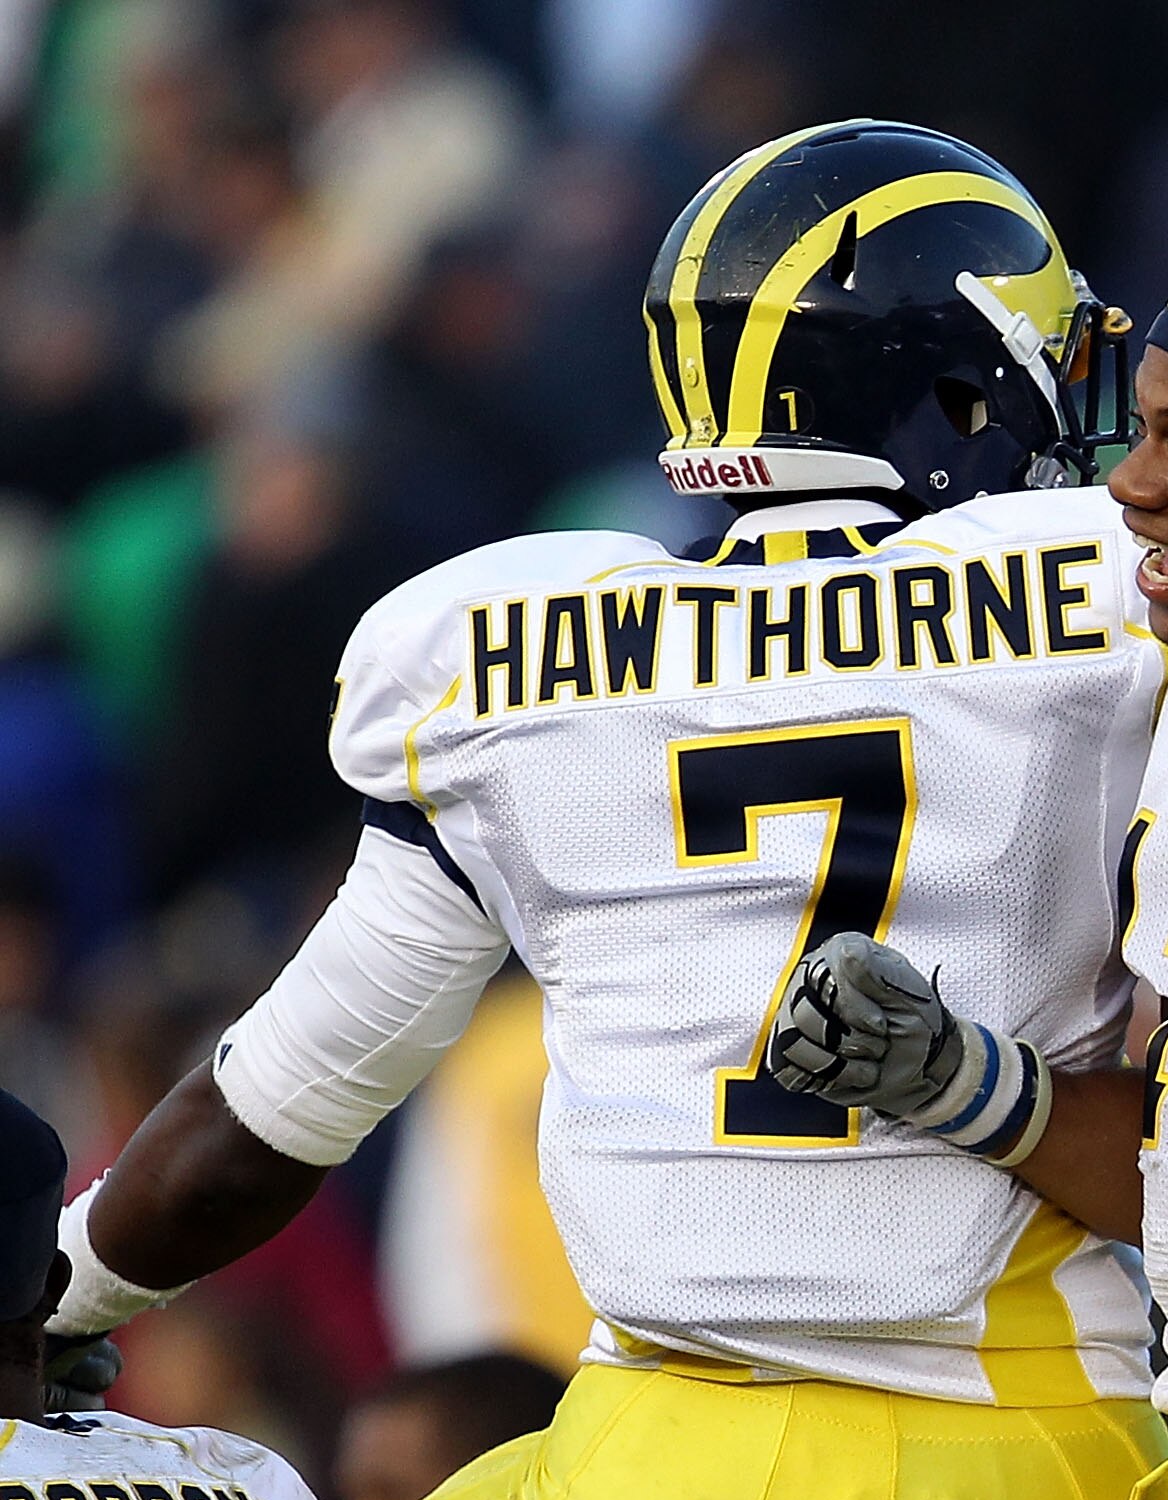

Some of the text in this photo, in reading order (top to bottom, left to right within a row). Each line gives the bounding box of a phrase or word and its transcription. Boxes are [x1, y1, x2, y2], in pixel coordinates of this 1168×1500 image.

[662, 455, 772, 491] Riddell
[467, 540, 1111, 719] HAWTHORNE
[670, 718, 916, 1146] 7
